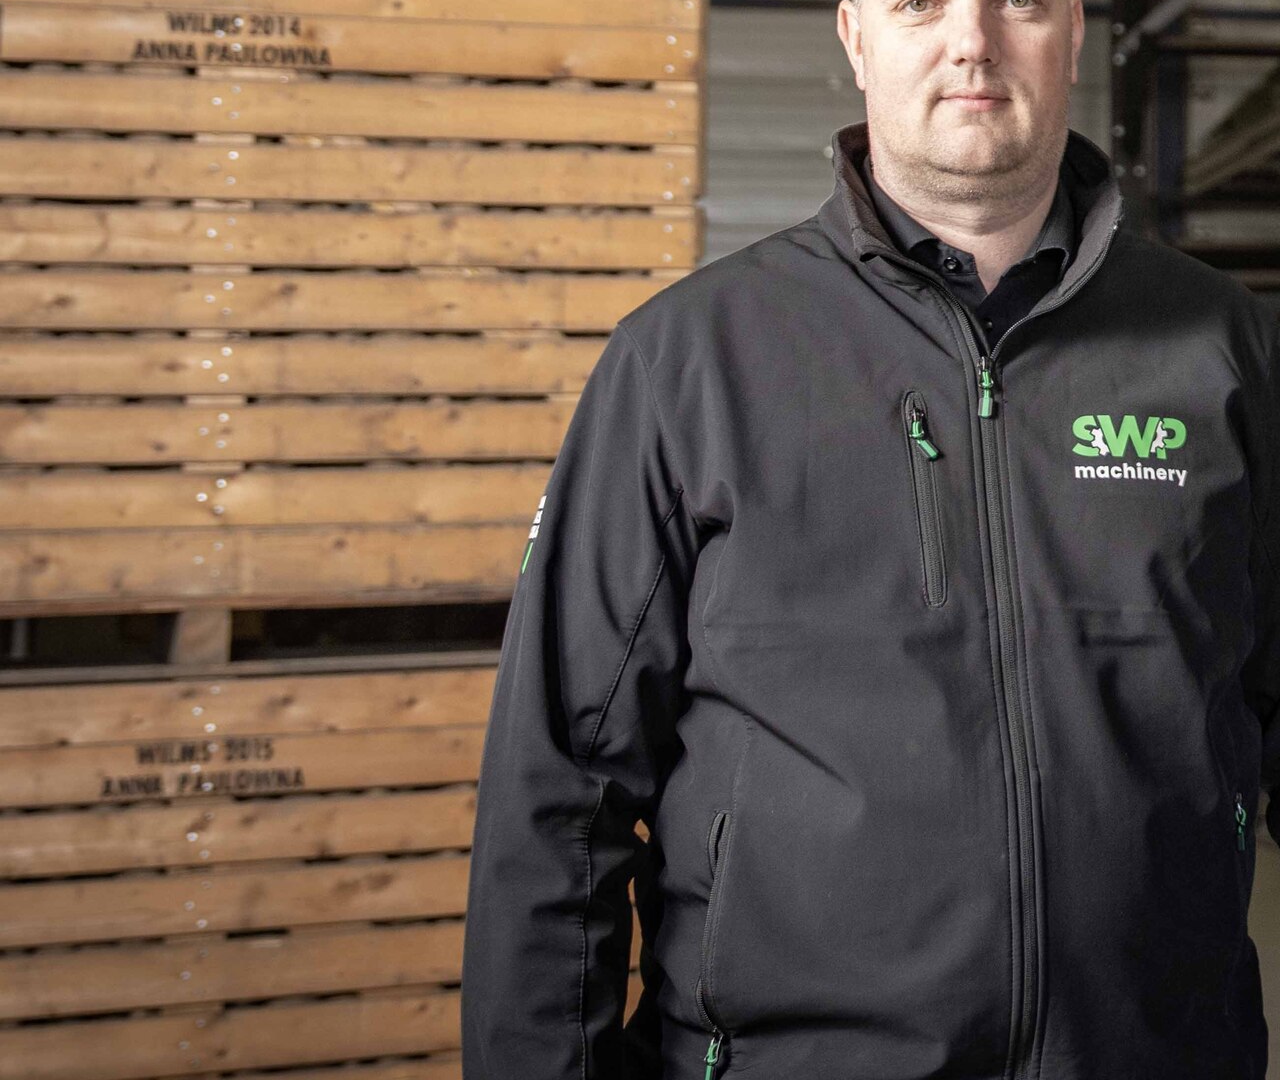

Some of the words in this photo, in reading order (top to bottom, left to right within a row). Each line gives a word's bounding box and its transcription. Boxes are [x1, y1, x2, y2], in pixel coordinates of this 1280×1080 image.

[166, 12, 243, 35] WILMS
[249, 15, 301, 37] 2014
[131, 39, 197, 62] ANNA
[205, 42, 333, 67] PAULOWNA
[1072, 414, 1187, 460] SWP
[1074, 461, 1188, 488] machinery
[136, 739, 213, 765] WILMS
[101, 775, 164, 797] ANNA
